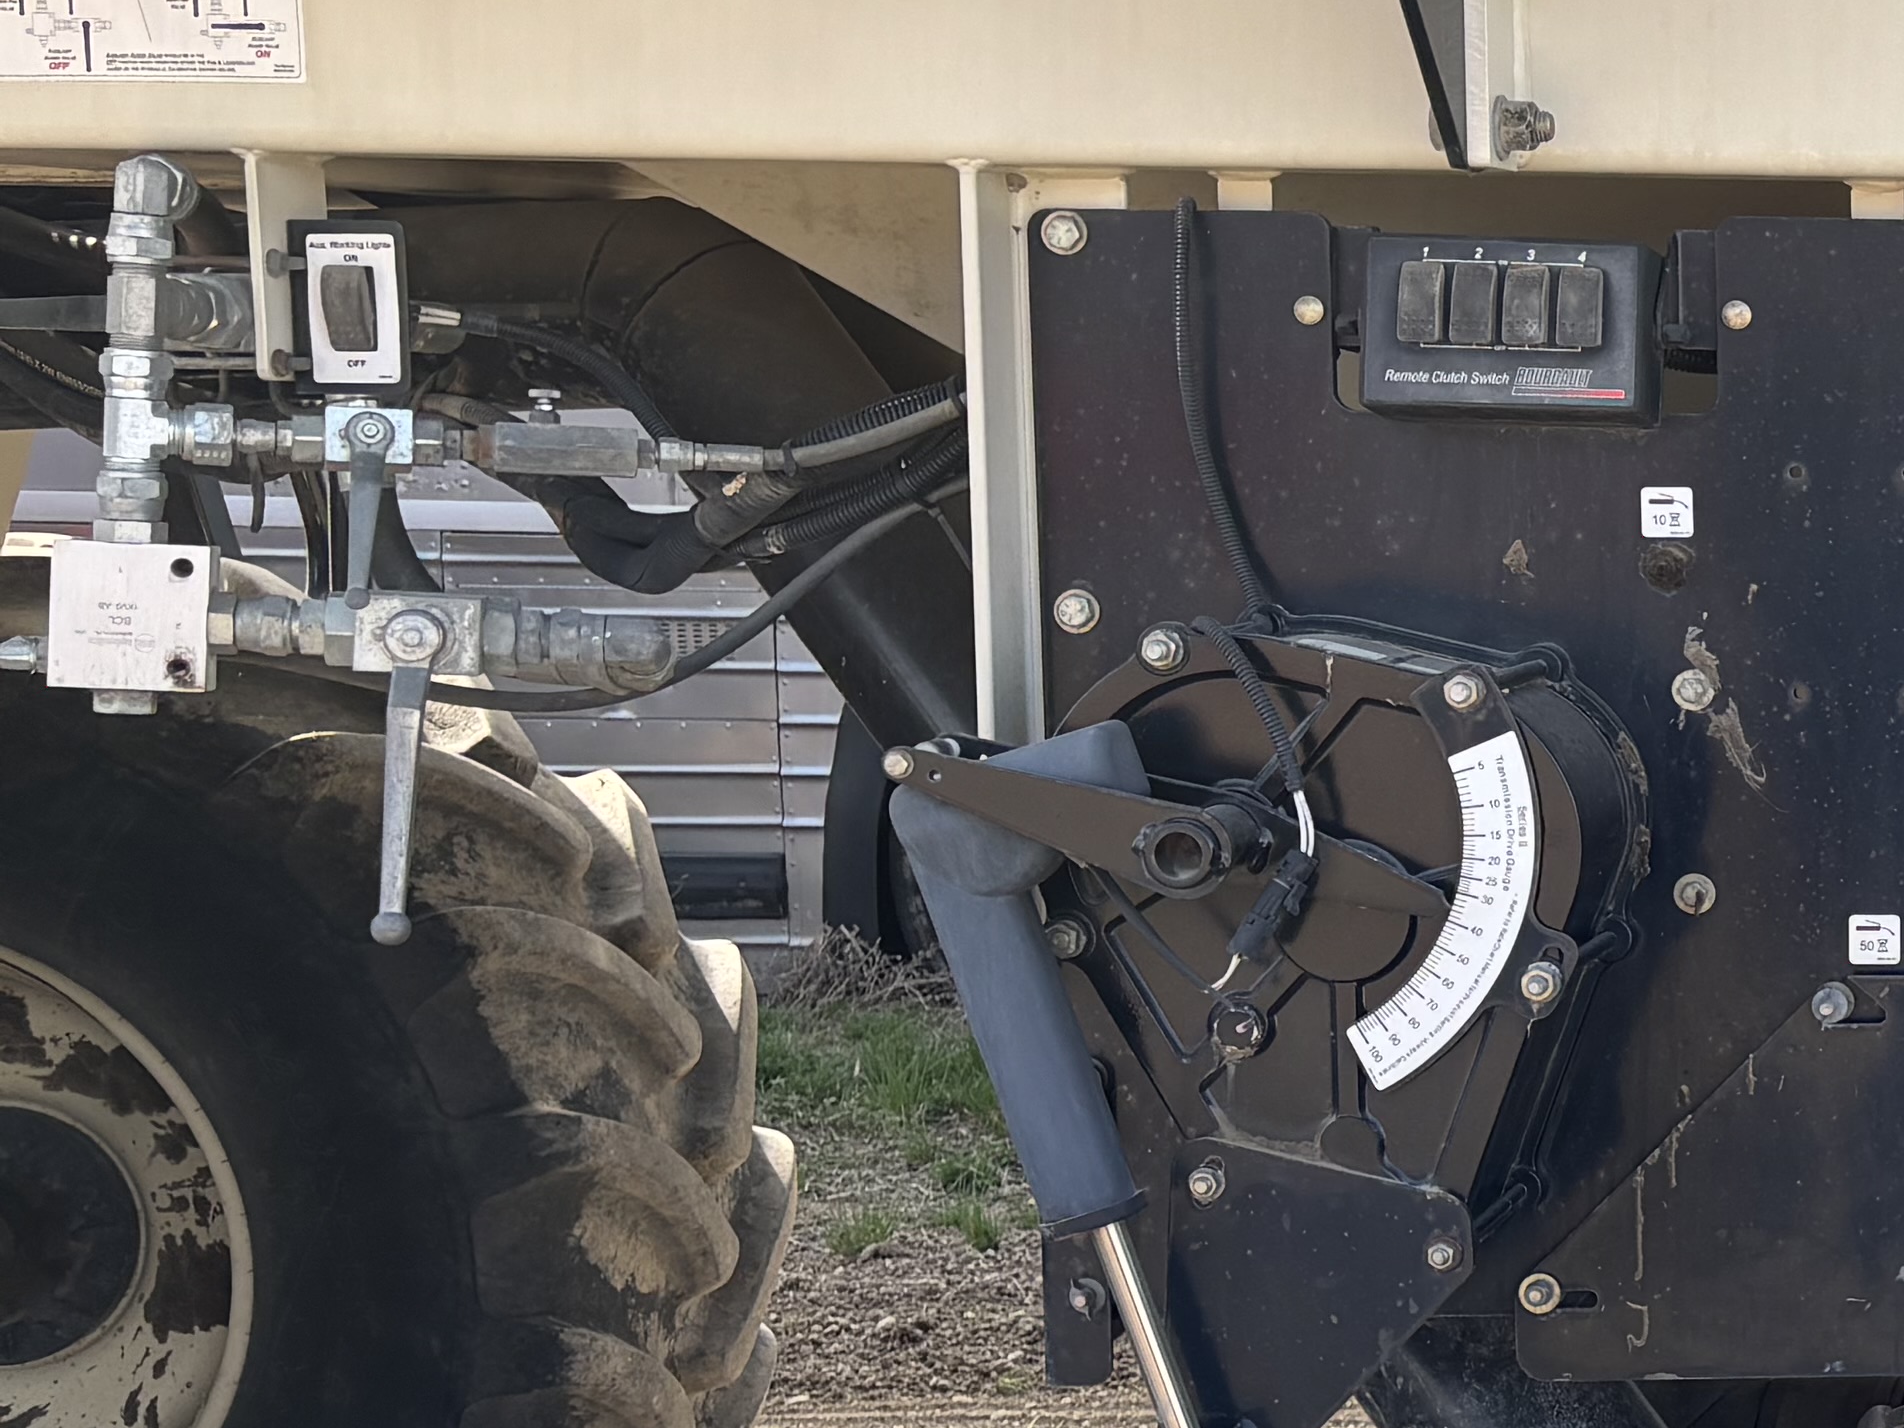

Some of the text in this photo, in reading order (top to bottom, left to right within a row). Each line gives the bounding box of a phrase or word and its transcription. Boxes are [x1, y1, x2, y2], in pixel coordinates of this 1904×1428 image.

[255, 50, 271, 58] ON
[49, 62, 70, 70] OFF
[343, 254, 359, 263] ON
[1422, 246, 1588, 261] 1 2 3 4
[347, 359, 367, 368] OFF
[1384, 369, 1429, 383] Remote
[1432, 370, 1468, 384] Clutch
[1470, 371, 1509, 385] Switch
[1652, 514, 1667, 526] 10
[1489, 799, 1500, 808] 10
[1495, 755, 1515, 892] Transmission Drive Gauge
[1490, 830, 1501, 840] 15
[1488, 856, 1501, 866] 20
[1480, 894, 1494, 905] 30
[1470, 926, 1483, 937] 40
[1860, 940, 1874, 952] 50
[1456, 955, 1470, 966] 50
[1426, 997, 1439, 1011] 70
[1368, 1045, 1383, 1063] 100
